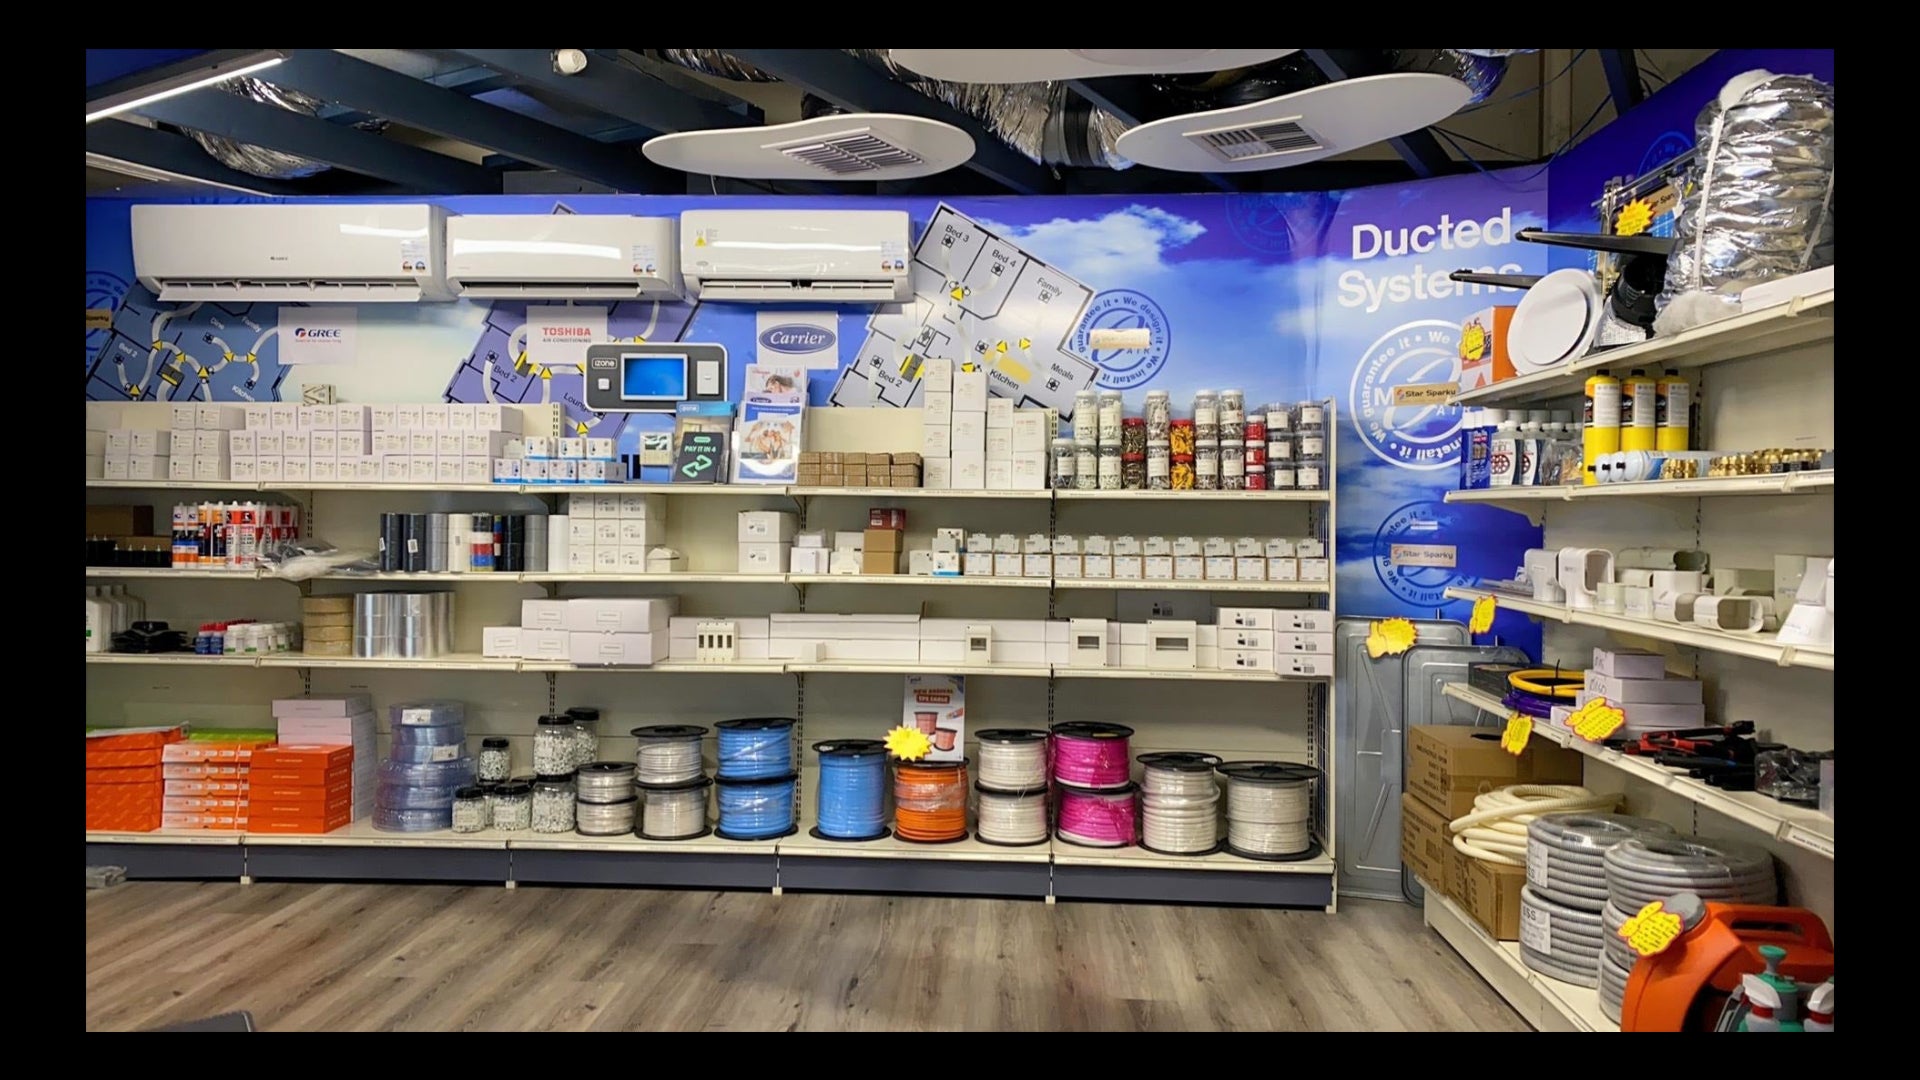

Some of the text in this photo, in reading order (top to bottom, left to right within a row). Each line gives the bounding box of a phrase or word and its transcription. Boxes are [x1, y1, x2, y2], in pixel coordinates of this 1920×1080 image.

[944, 223, 971, 244] Bed 3
[1353, 206, 1512, 260] Ducted
[991, 248, 1017, 269] Bed 4
[1036, 276, 1064, 298] Family
[1337, 262, 1524, 314] Systems
[1103, 298, 1112, 308] it
[1122, 296, 1139, 306] We
[1139, 303, 1163, 335] design
[308, 328, 342, 338] GREE
[542, 327, 592, 336] TOSHIBA
[769, 331, 826, 345] Carrier
[1077, 305, 1102, 353] guarantee
[1428, 330, 1450, 344] We
[1398, 336, 1411, 350] it
[1145, 355, 1160, 369] We
[493, 363, 519, 384] Bed 2
[878, 369, 903, 388] Bed 2
[988, 367, 1020, 391] Kitchen
[1050, 362, 1075, 382] Meals
[1101, 372, 1111, 381] it
[1112, 368, 1147, 385] install
[1361, 346, 1396, 418] guarantee
[1405, 388, 1457, 398] Star Sparky
[1369, 422, 1388, 444] We
[684, 445, 698, 453] PAY
[1398, 436, 1462, 461] nstall it
[1408, 510, 1418, 520] it
[1402, 550, 1455, 560] Star Sparky
